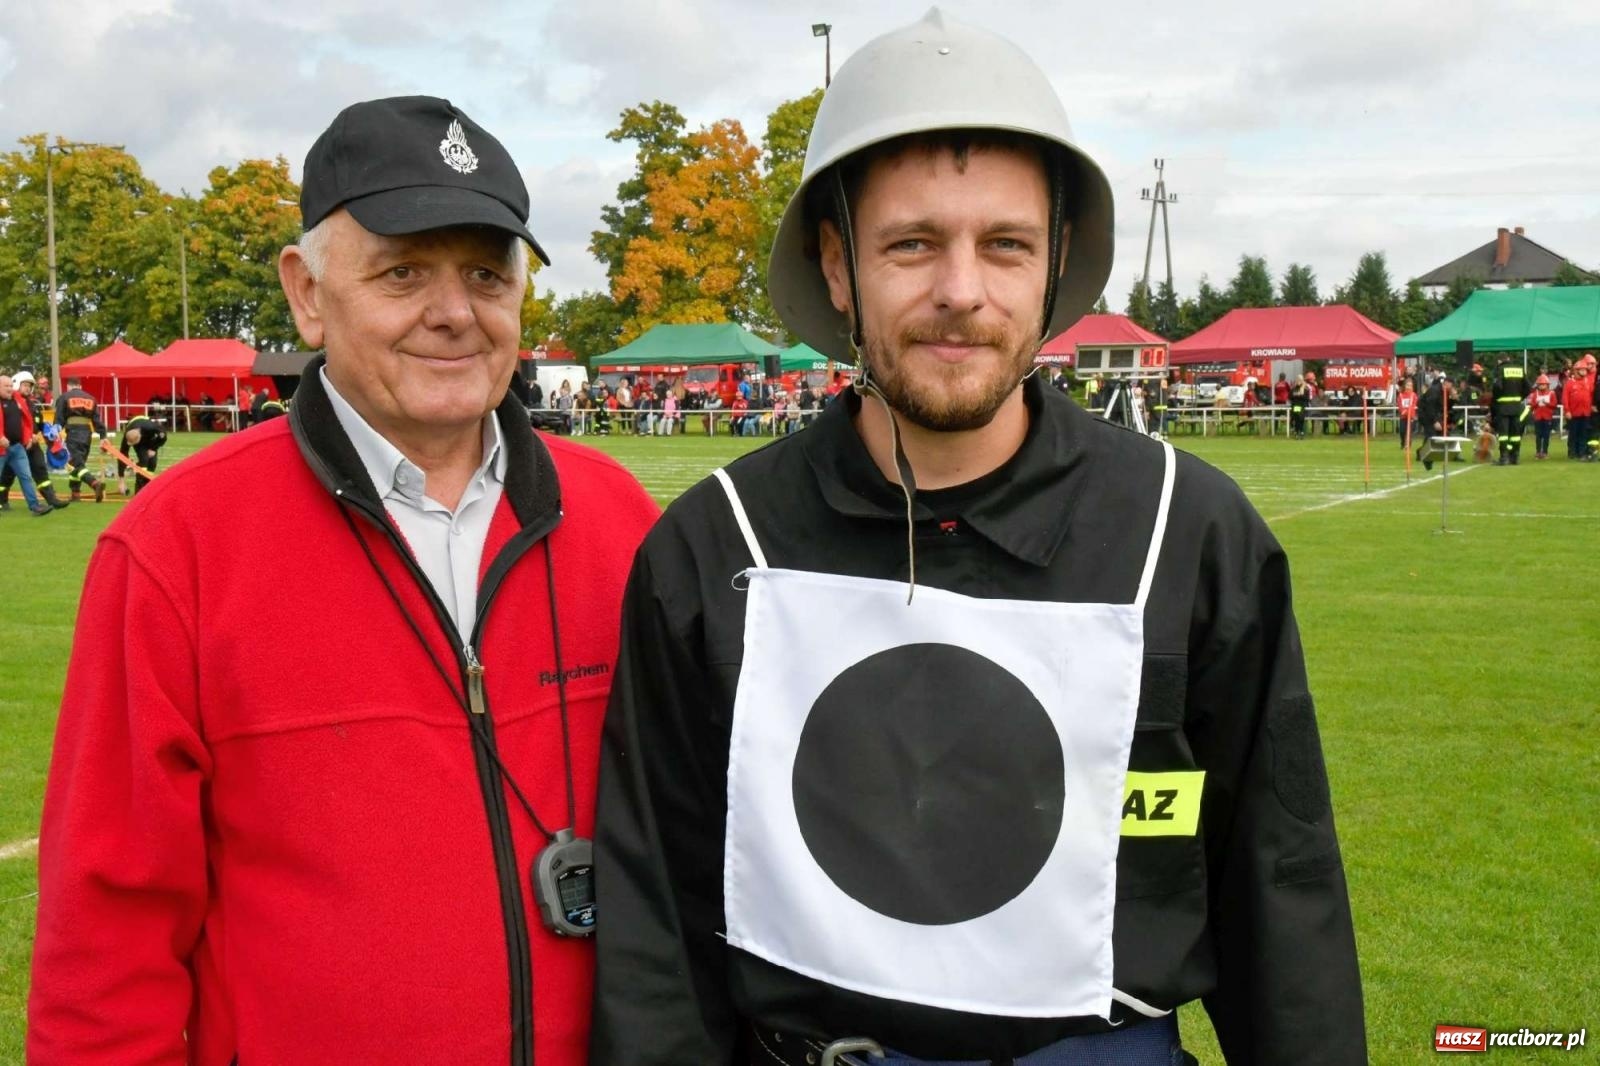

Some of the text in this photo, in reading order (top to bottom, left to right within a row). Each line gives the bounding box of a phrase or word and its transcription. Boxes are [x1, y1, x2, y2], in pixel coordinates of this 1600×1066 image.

[1251, 348, 1297, 357] KROWIARKI
[1033, 354, 1071, 363] ROWIARKI
[1350, 366, 1383, 378] POŻARNA
